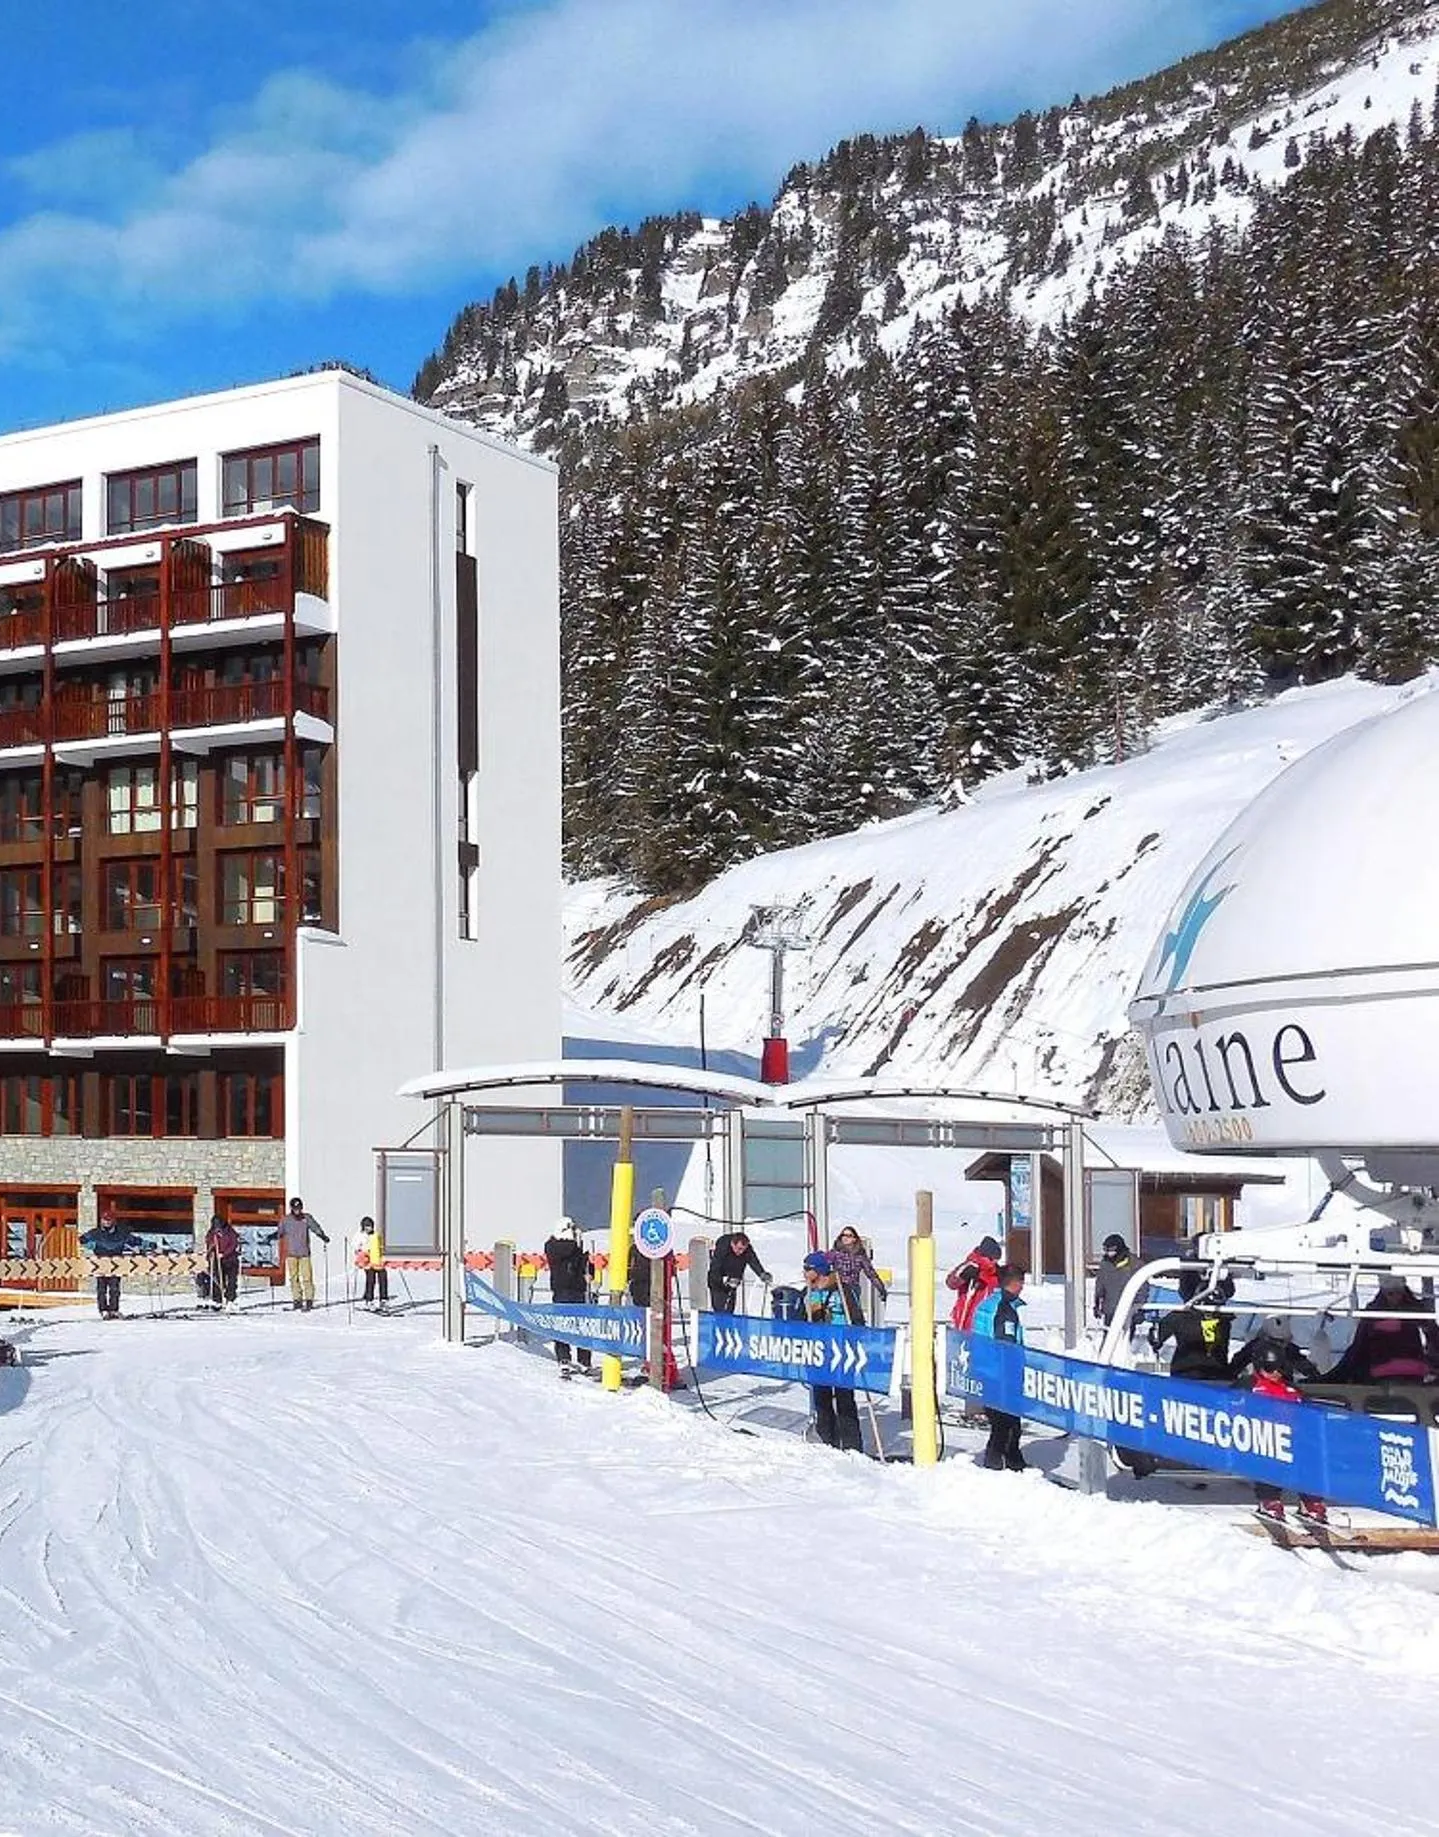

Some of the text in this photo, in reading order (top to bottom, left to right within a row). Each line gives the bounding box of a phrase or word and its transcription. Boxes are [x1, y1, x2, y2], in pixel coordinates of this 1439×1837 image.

[748, 1334, 826, 1368] SAMOENS
[1022, 1366, 1145, 1429] BIENVENUE
[1162, 1398, 1294, 1464] WELCOME
